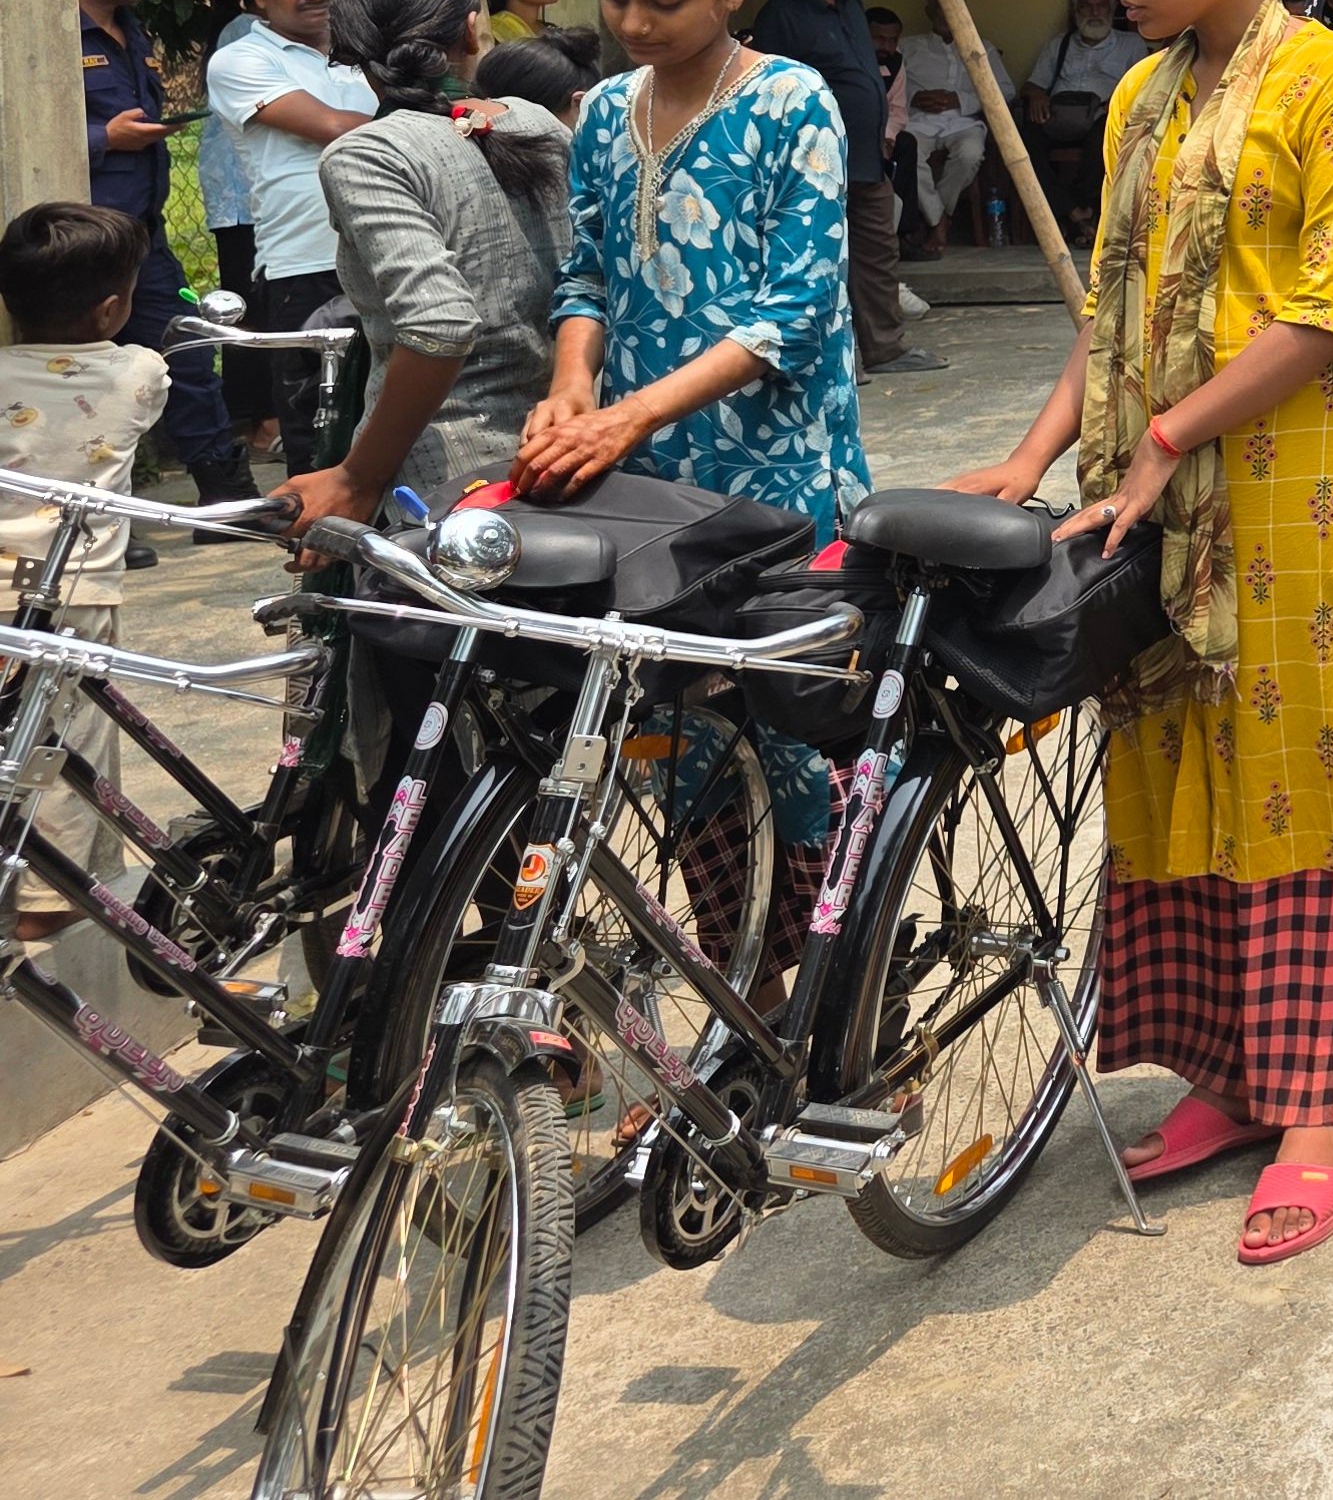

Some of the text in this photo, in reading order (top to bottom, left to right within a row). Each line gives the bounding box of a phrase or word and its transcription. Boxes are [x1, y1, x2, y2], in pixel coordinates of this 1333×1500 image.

[94, 774, 173, 850] QUEEN
[359, 779, 428, 933] LEADER
[834, 752, 888, 909] LEADER
[74, 1002, 186, 1094] QUEEN
[615, 1000, 695, 1089] QUEEN
